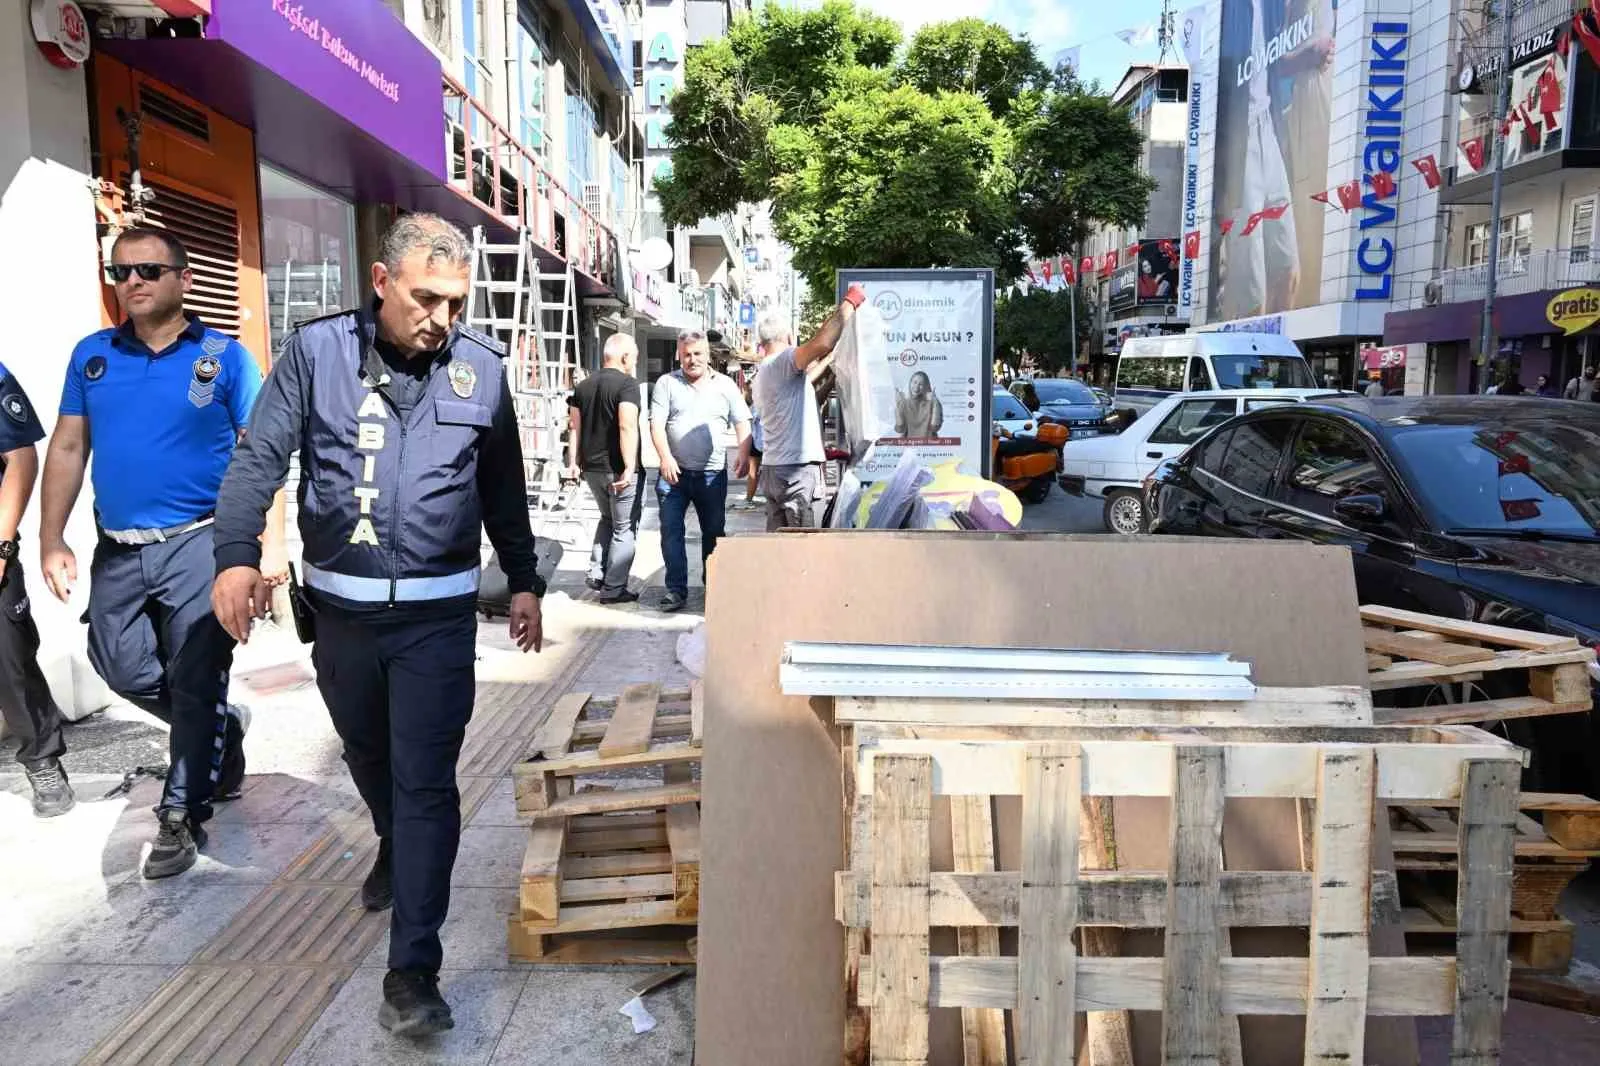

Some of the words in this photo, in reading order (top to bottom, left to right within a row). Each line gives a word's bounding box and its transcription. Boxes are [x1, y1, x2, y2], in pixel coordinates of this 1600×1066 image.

[1513, 28, 1555, 61] YALDIZ
[904, 296, 956, 307] dinamik
[1553, 292, 1599, 321] gratis
[911, 331, 962, 343] MUSUN
[966, 331, 974, 343] ?
[349, 374, 391, 546] ABITA
